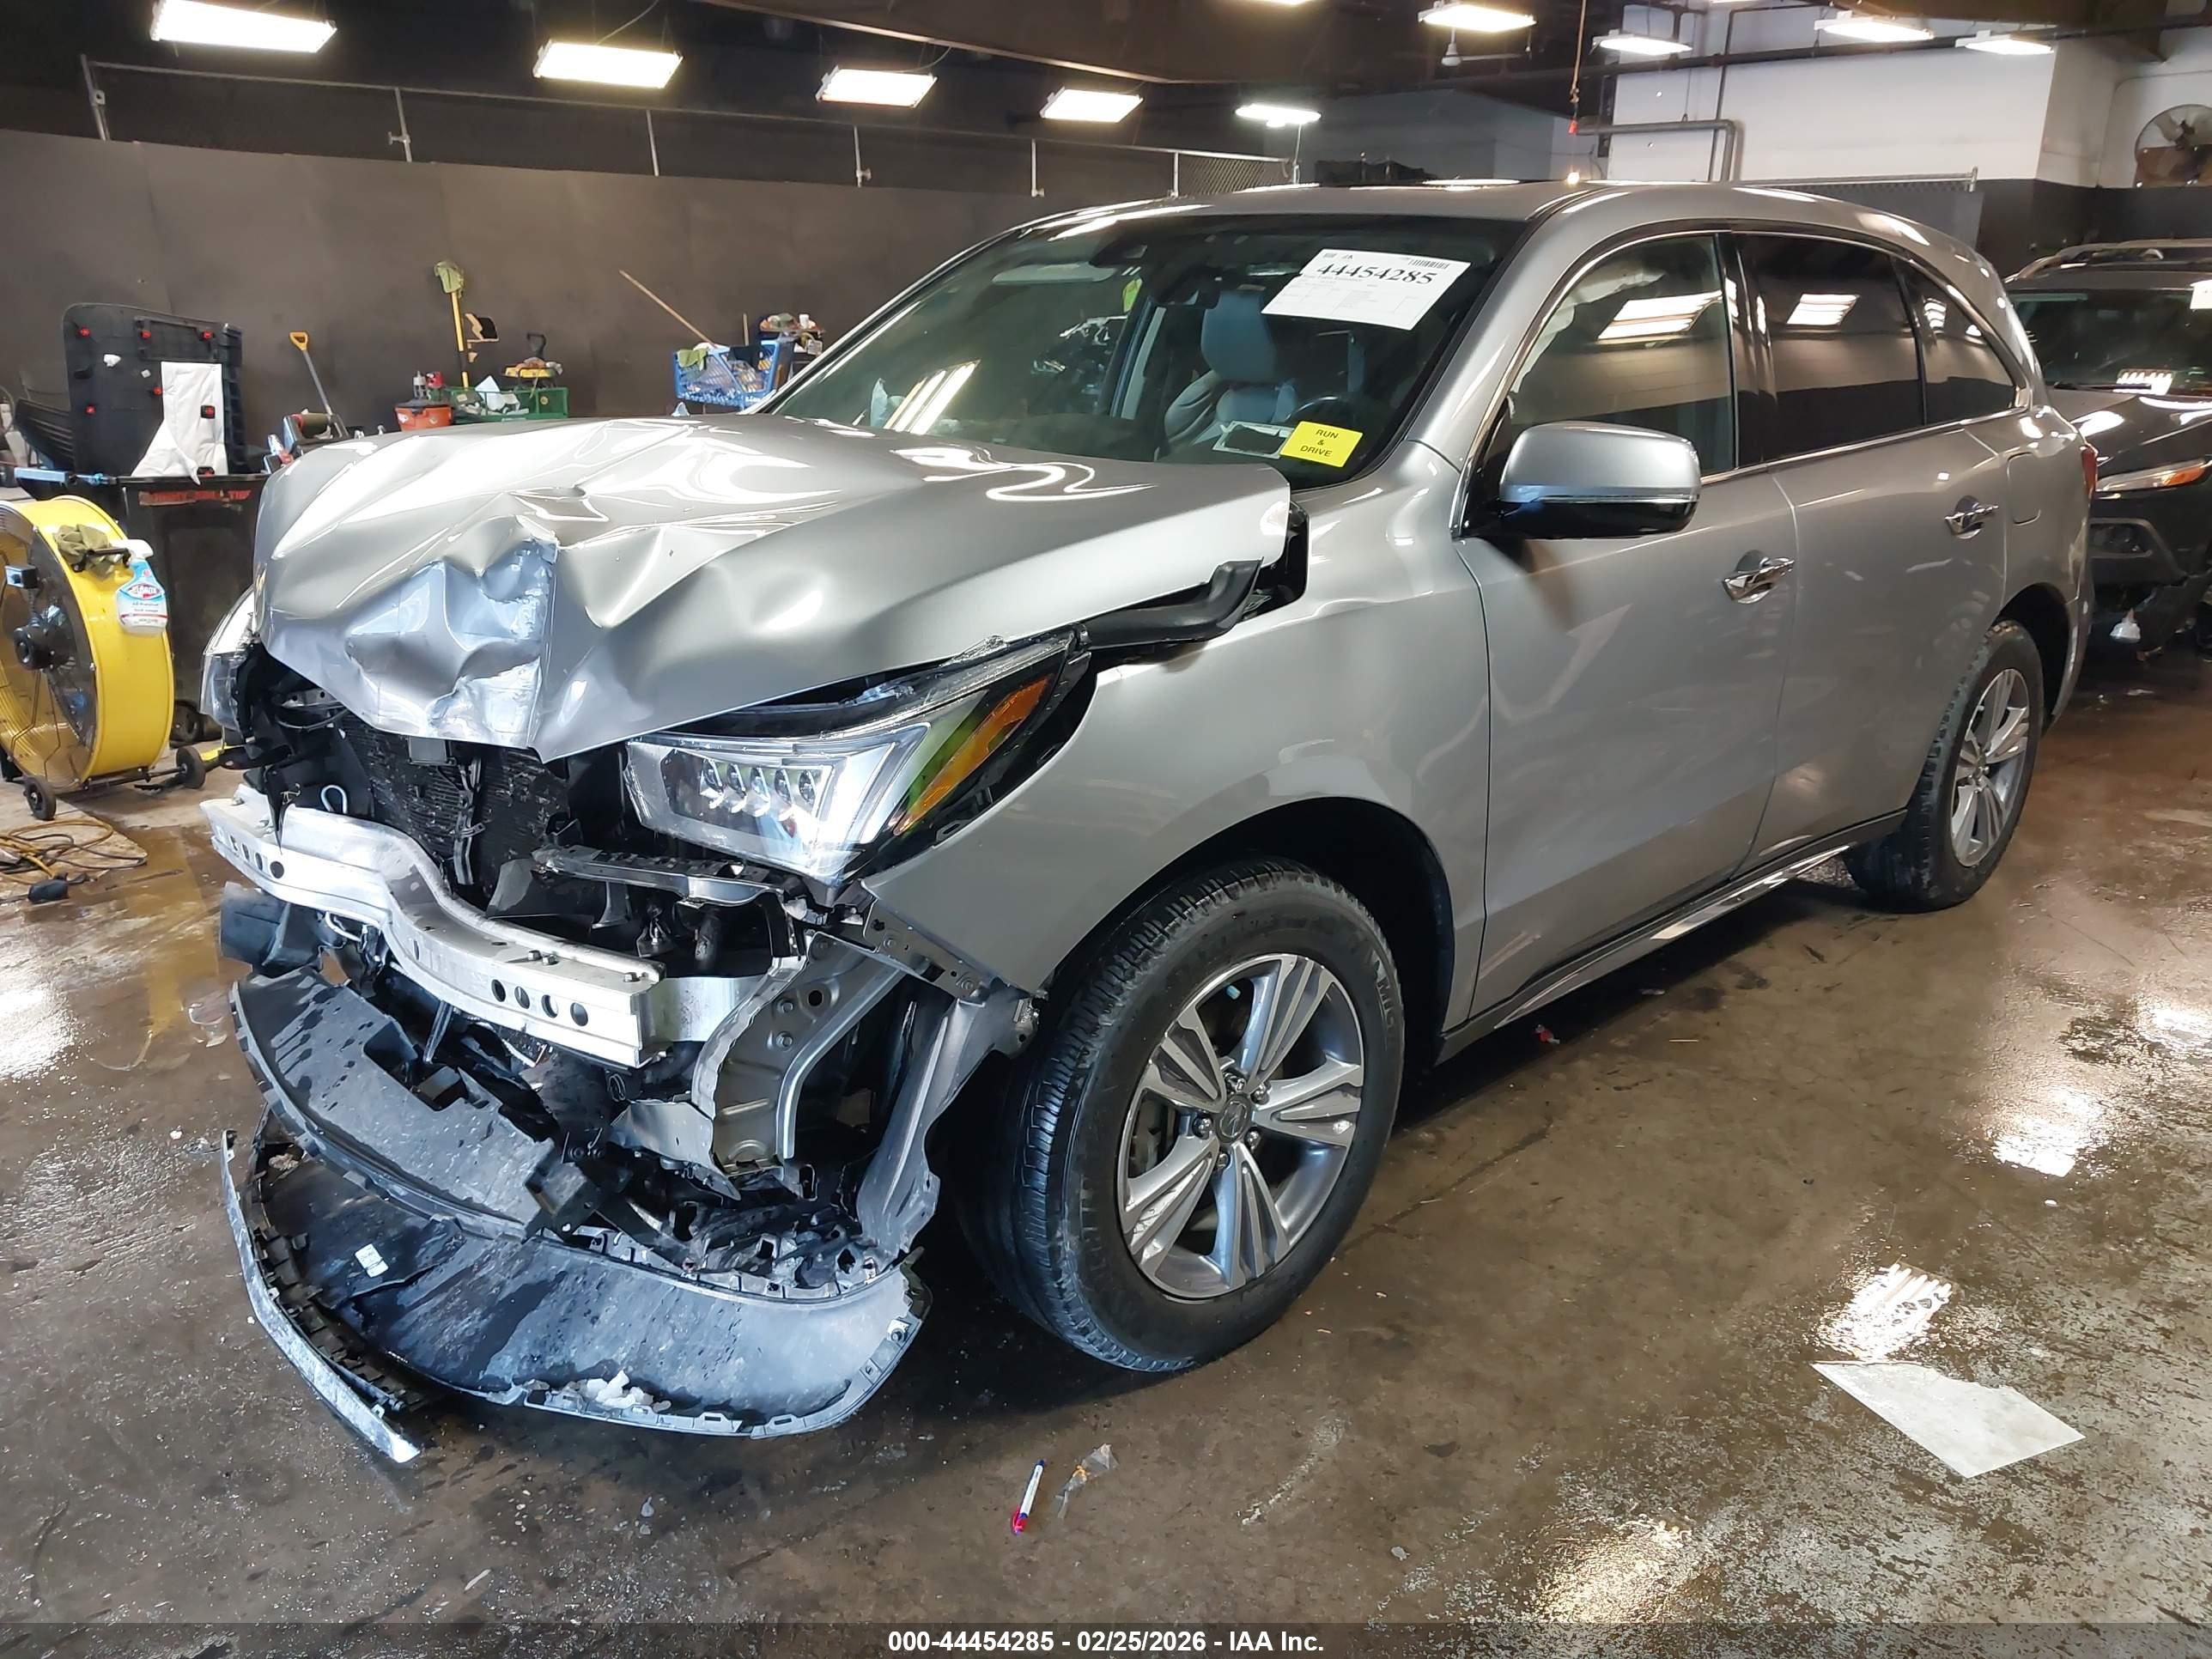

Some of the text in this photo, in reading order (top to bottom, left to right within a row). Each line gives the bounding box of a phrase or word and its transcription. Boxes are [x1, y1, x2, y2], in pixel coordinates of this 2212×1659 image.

[1316, 263, 1437, 284] 44454285
[1316, 428, 1339, 439] RUN
[1300, 445, 1333, 457] DRIVE
